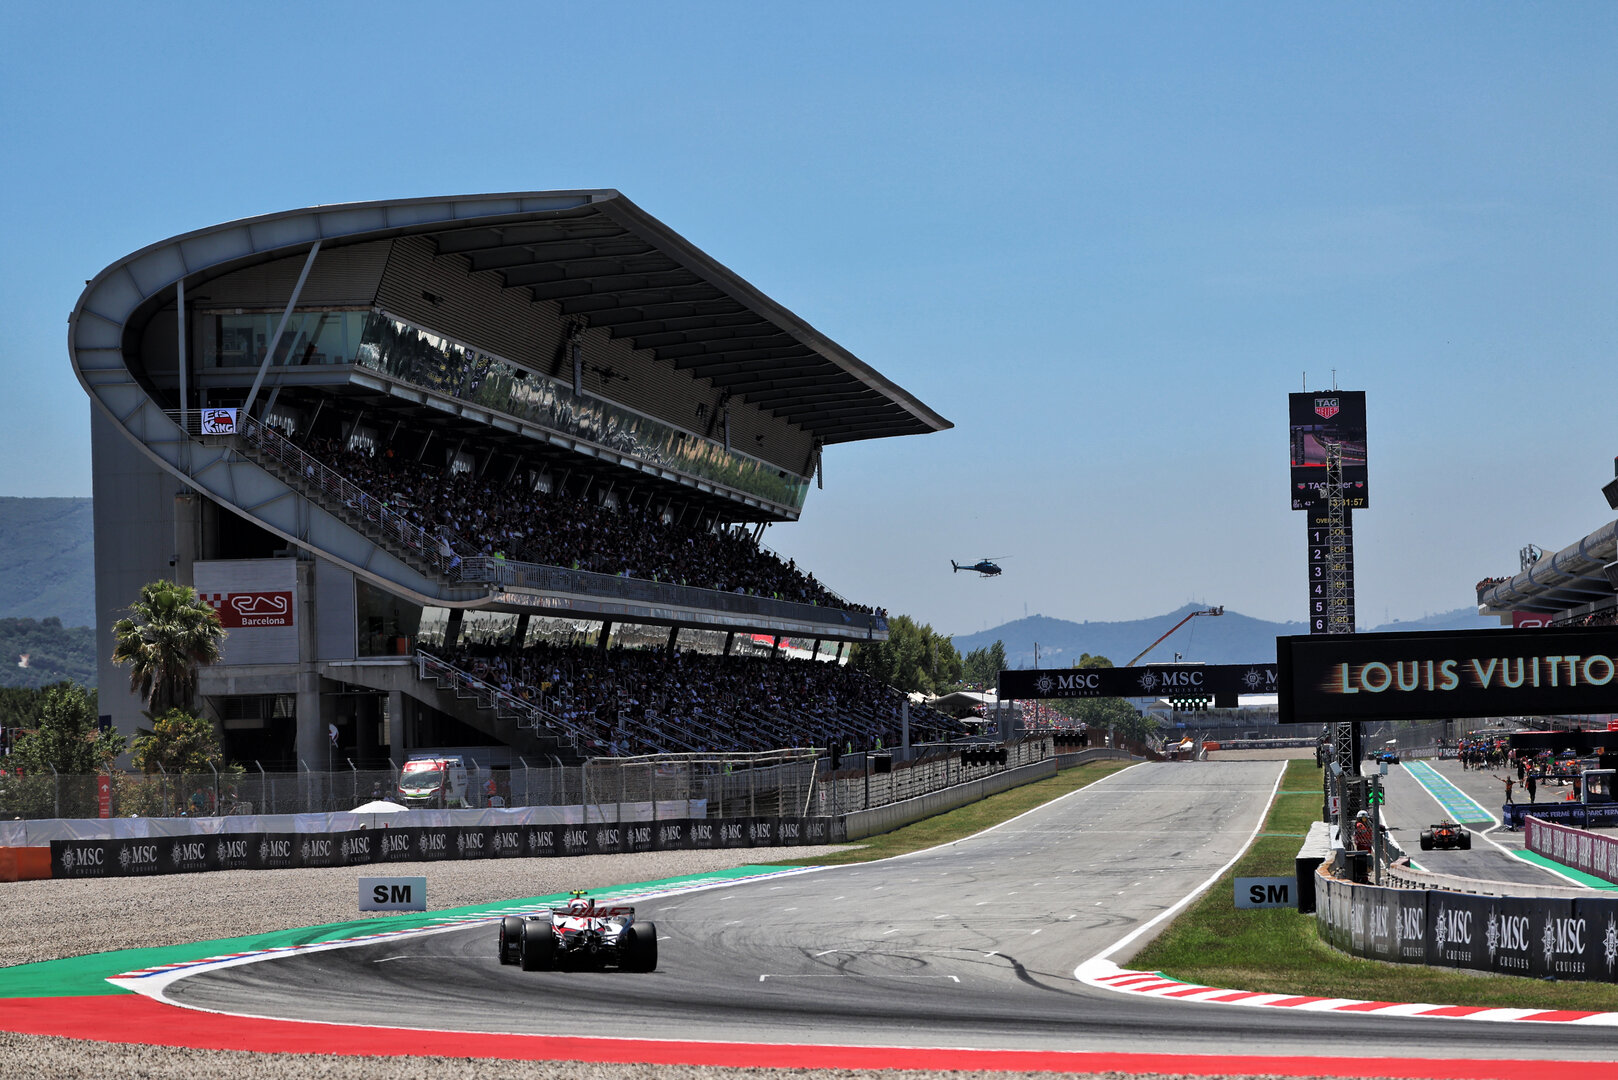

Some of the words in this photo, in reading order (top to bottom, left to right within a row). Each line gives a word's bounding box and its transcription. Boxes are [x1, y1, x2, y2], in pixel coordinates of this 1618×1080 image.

[1317, 399, 1337, 407] TAG
[1315, 406, 1339, 417] HEUER
[1314, 531, 1320, 542] 1
[1314, 549, 1321, 560] 2
[1315, 566, 1322, 577] 3
[1315, 585, 1322, 595] 4
[1316, 601, 1323, 612] 5
[241, 616, 285, 626] Barcelona
[1316, 619, 1323, 630] 6
[1057, 674, 1099, 689] MSC
[1161, 671, 1203, 686] MSC
[1342, 659, 1459, 694] LOUIS
[1472, 655, 1615, 689] VUITTO
[571, 830, 588, 846] MSC
[604, 828, 620, 844] MSC
[635, 827, 651, 843] MSC
[667, 825, 682, 840] MSC
[697, 825, 713, 840] MSC
[728, 824, 742, 839] MSC
[756, 823, 771, 838] MSC
[350, 836, 370, 854] MSC
[389, 834, 410, 851] MSC
[428, 834, 447, 850] MSC
[465, 833, 484, 849] MSC
[501, 832, 519, 848] MSC
[536, 831, 554, 847] MSC
[76, 847, 104, 866] MSC
[132, 845, 158, 863] MSC
[182, 843, 205, 860] MSC
[226, 841, 247, 858] MSC
[270, 840, 291, 857] MSC
[311, 840, 331, 857] MSC
[373, 885, 412, 904] SM
[1249, 884, 1289, 904] SM
[1403, 907, 1424, 940] MSC
[1447, 909, 1472, 944] MSC
[1500, 915, 1530, 951] MSC
[1555, 918, 1586, 954] MSC
[1403, 946, 1424, 957] CRUISES
[1446, 949, 1472, 962] CRUISES
[1499, 955, 1530, 970] CRUISES
[1555, 960, 1586, 973] CRUISES
